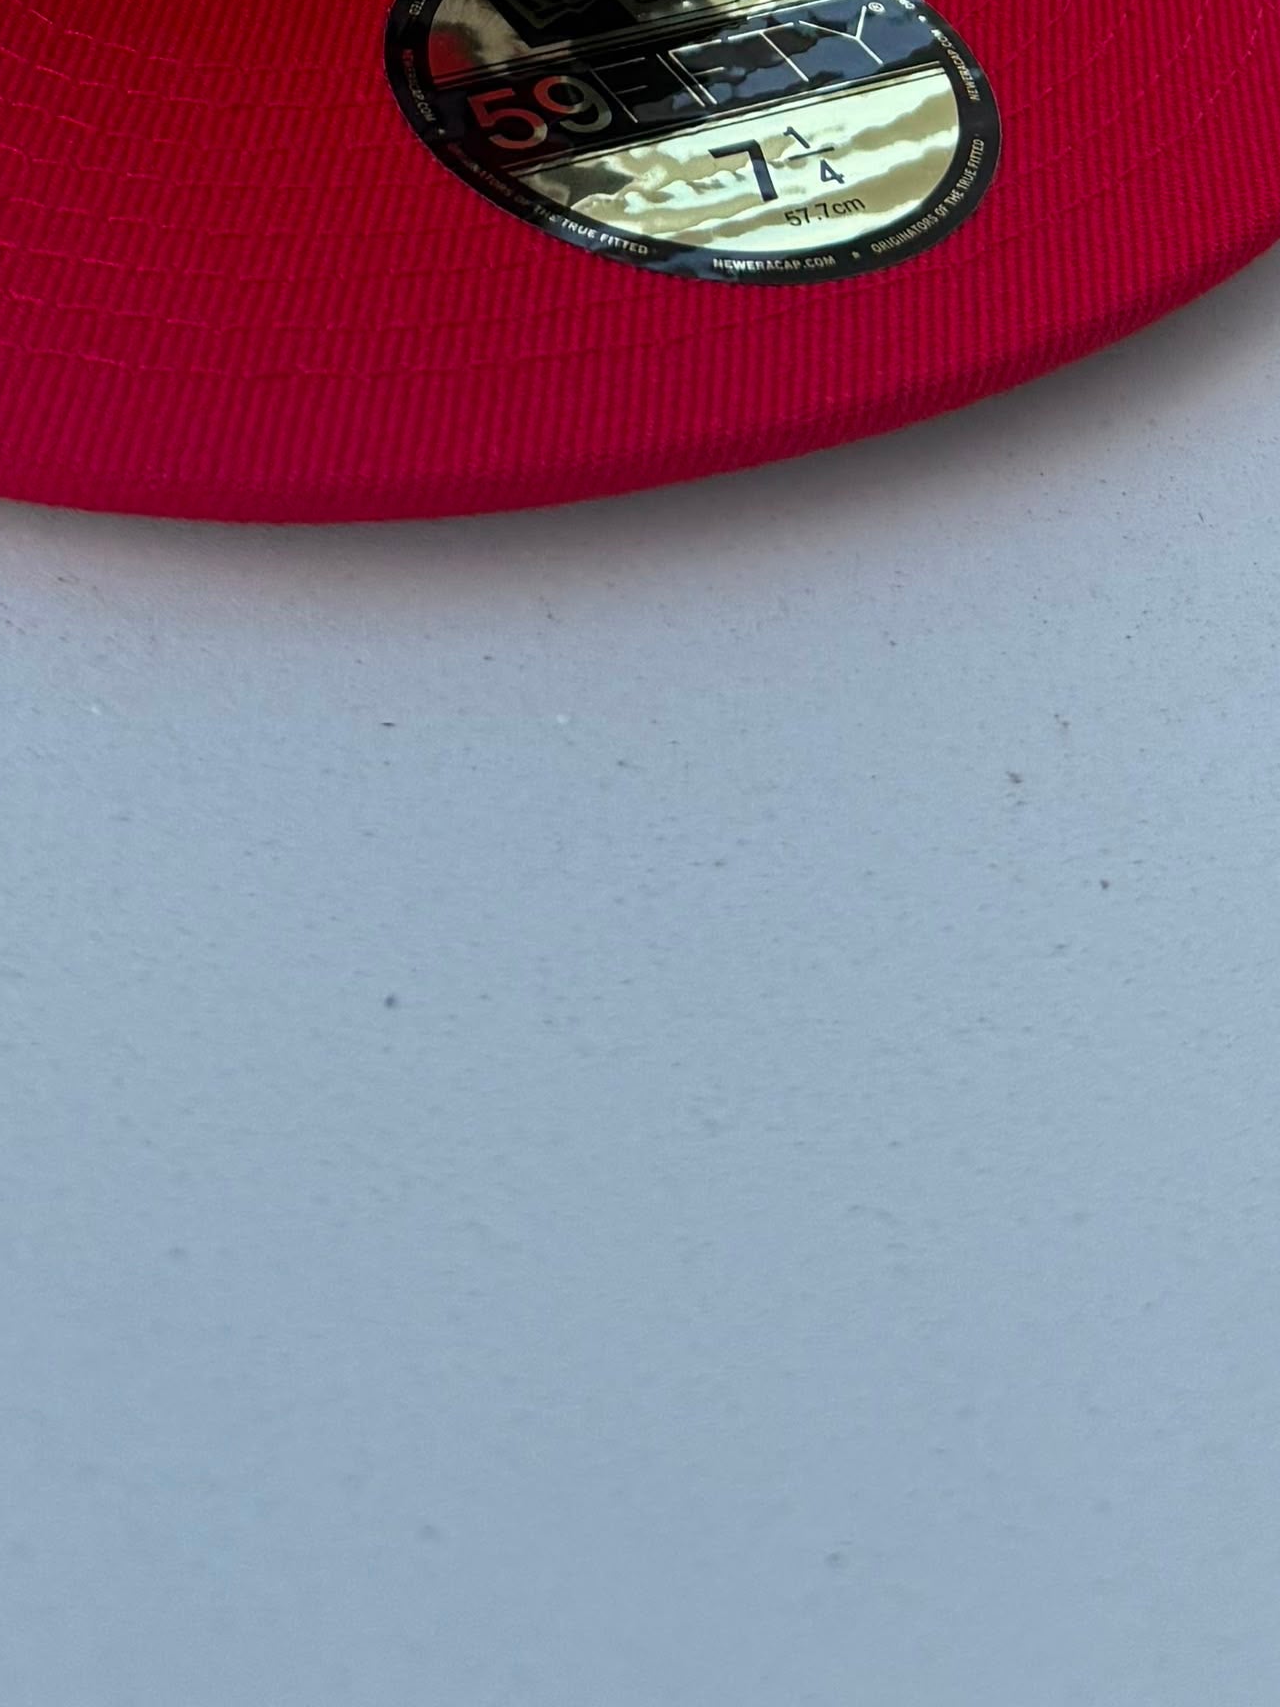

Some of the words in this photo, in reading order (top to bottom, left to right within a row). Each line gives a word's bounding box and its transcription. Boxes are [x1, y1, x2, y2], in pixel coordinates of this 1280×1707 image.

[784, 196, 867, 228] 57.7cm
[870, 210, 941, 255] ORIGINATORS
[945, 187, 966, 211] THE
[956, 161, 978, 192] TRUE
[968, 138, 986, 167] FITTED
[561, 218, 598, 239] TRUE
[599, 232, 649, 256] FITTED
[712, 255, 837, 272] NEWERACAP.COM
